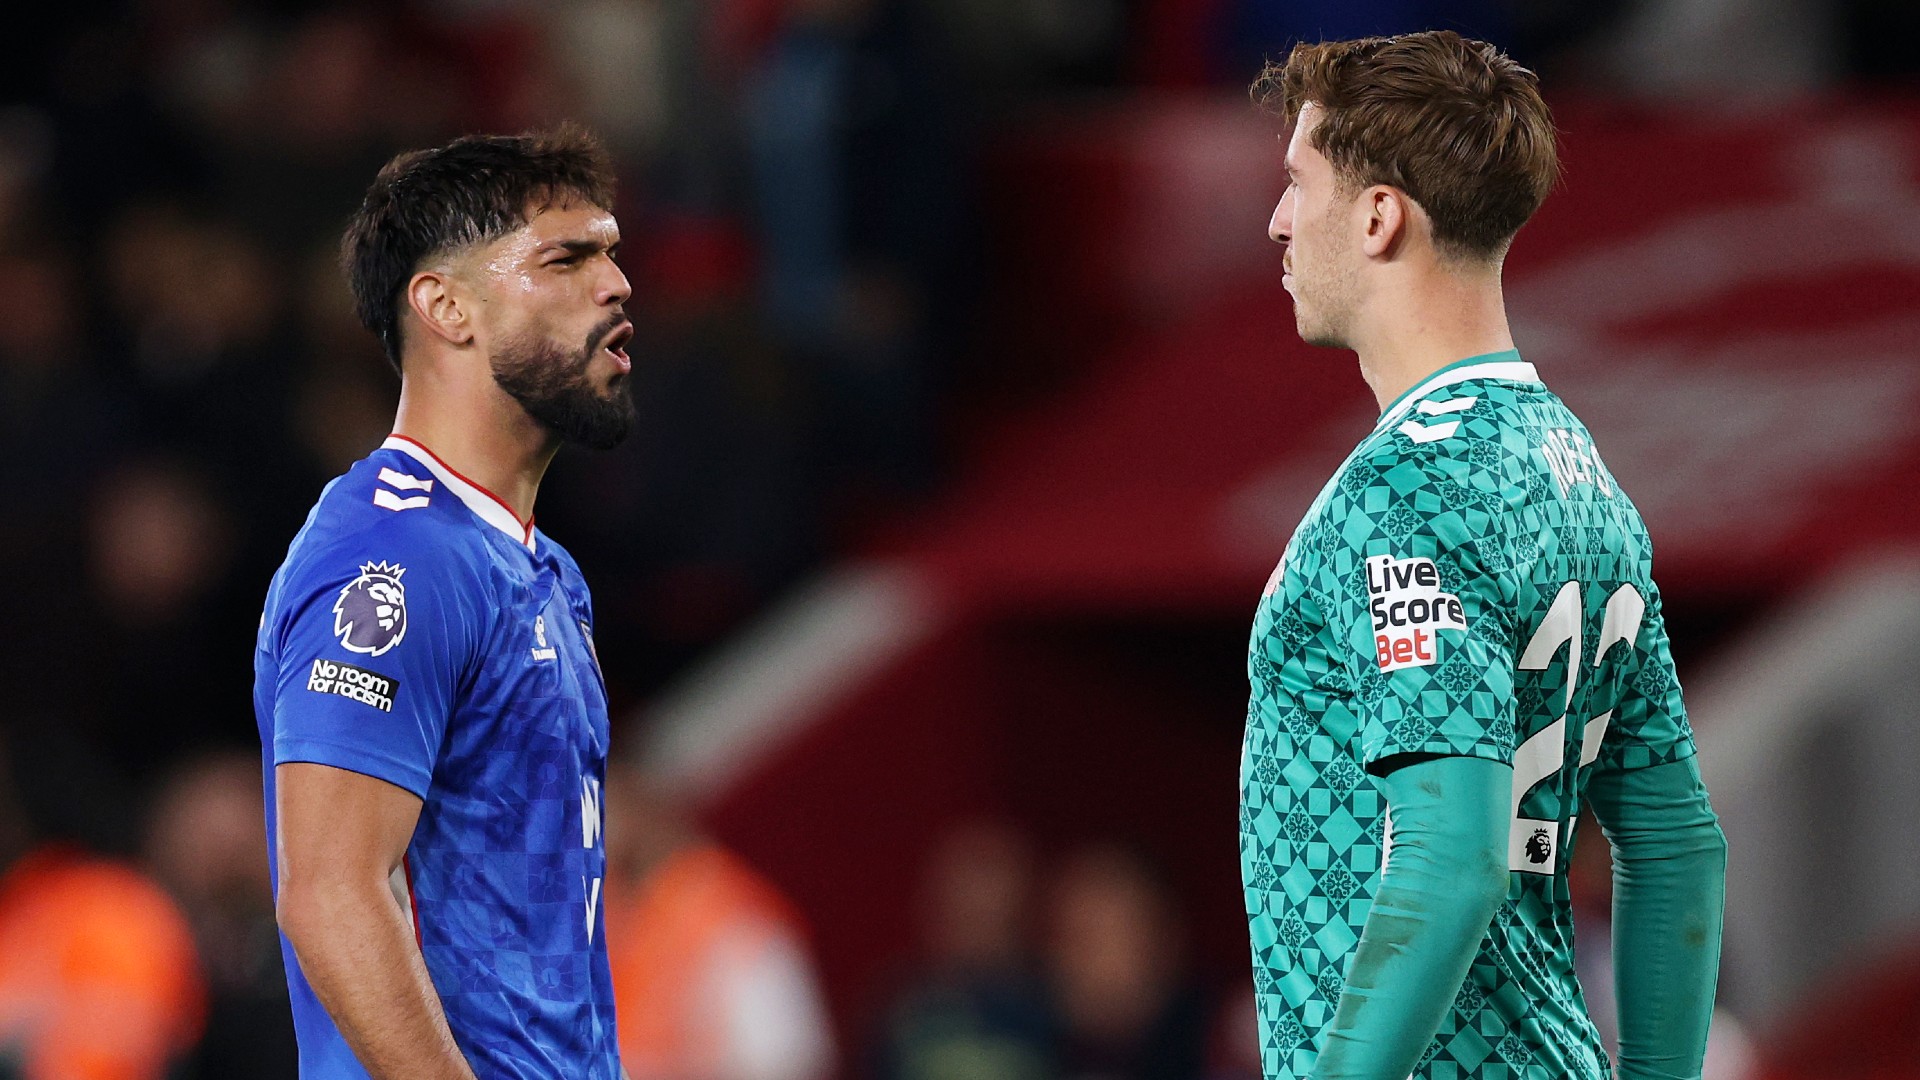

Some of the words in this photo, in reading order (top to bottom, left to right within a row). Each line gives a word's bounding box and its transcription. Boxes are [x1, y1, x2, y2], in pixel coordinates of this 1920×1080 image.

[1367, 558, 1437, 594] Live
[1371, 596, 1464, 631] Score
[1376, 628, 1431, 668] Bet
[307, 674, 334, 693] for
[333, 680, 392, 713] racism
[311, 659, 338, 679] No
[339, 666, 389, 695] room
